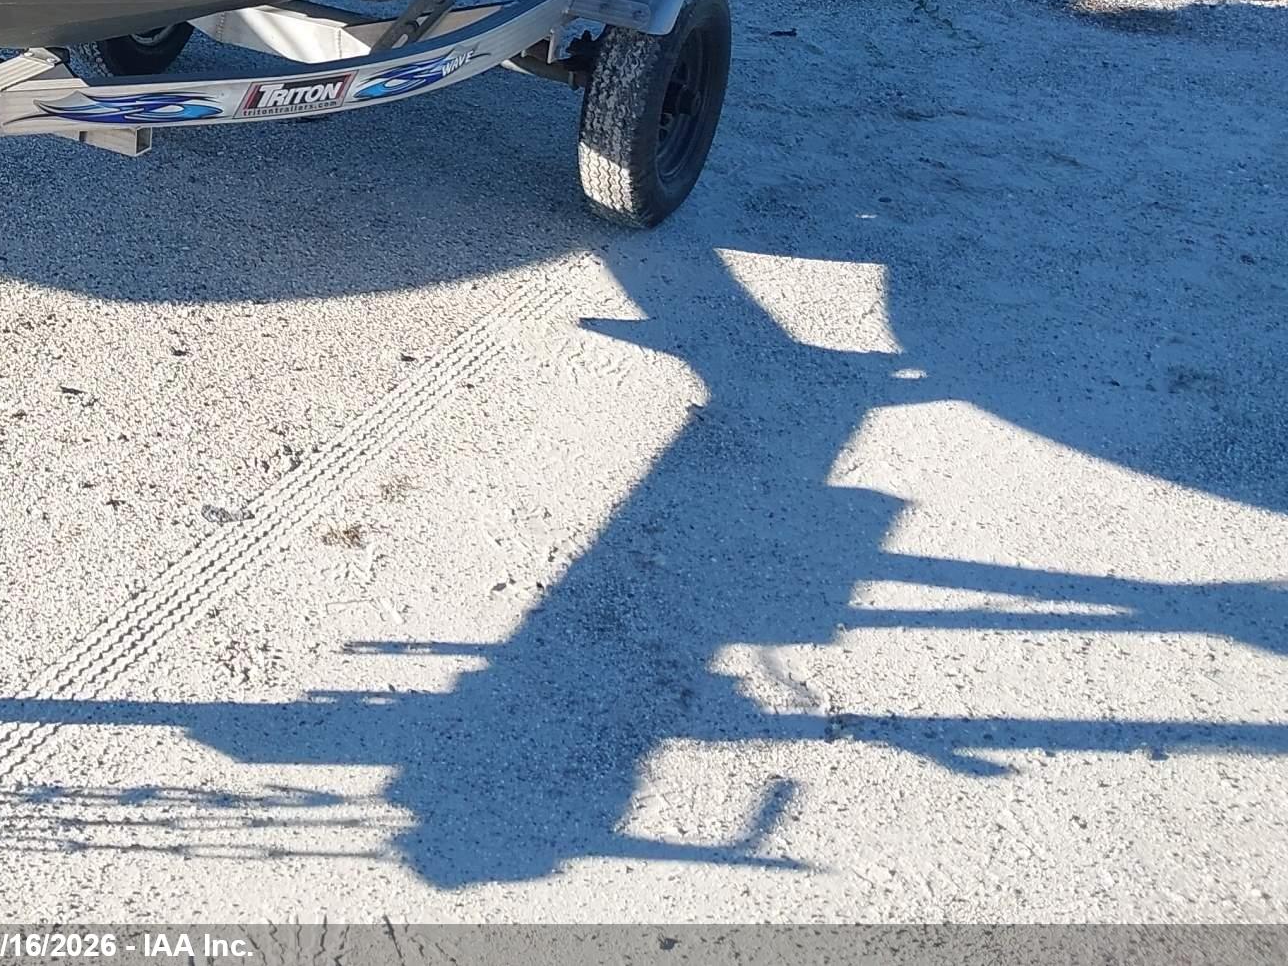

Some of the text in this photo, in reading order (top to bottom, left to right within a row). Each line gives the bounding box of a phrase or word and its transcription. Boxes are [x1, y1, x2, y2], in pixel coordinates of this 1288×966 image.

[441, 49, 475, 78] WAVE
[242, 100, 338, 117] tritontrailers.com
[258, 81, 344, 109] TRITON
